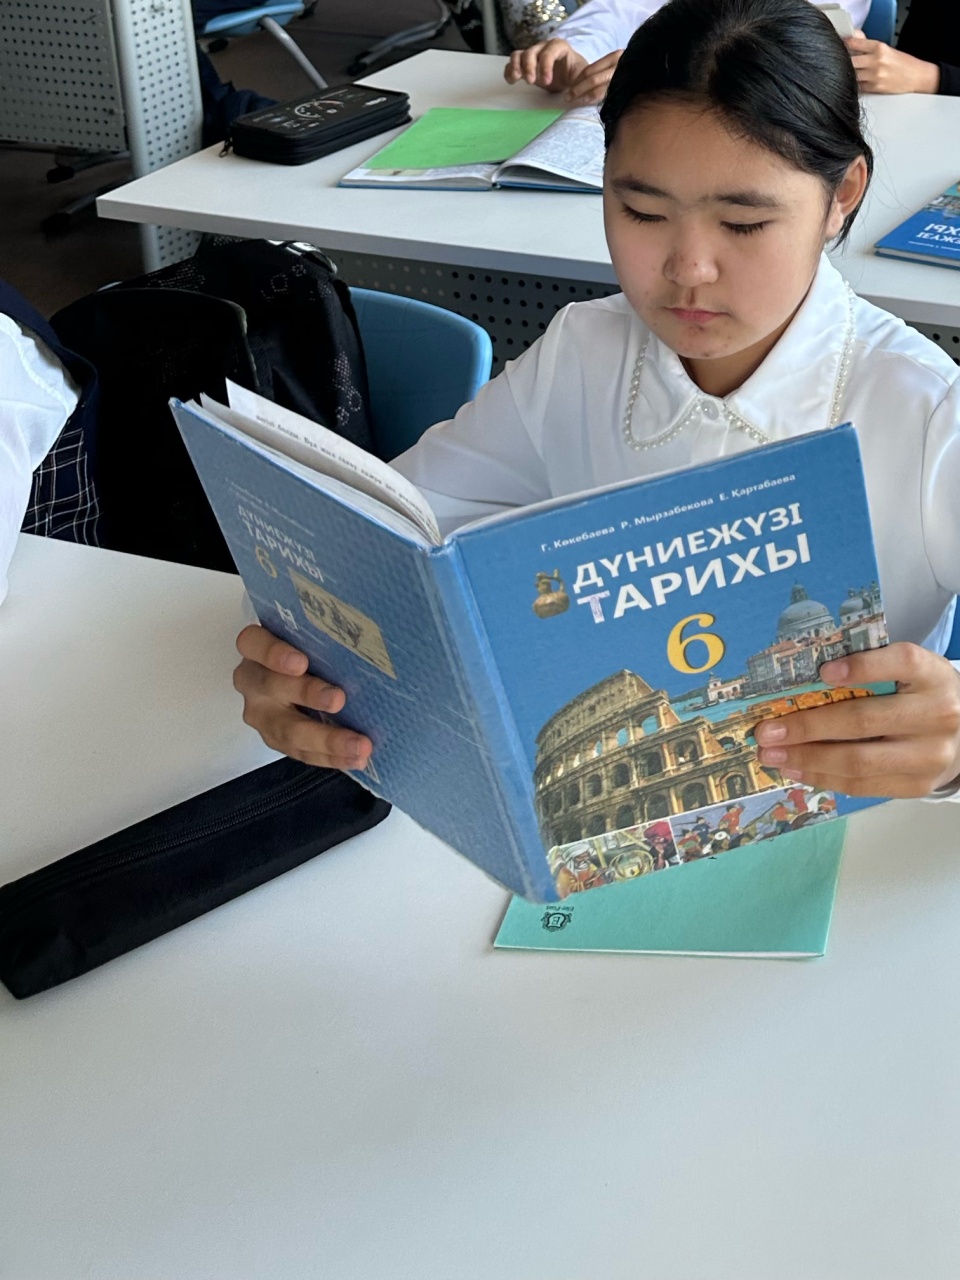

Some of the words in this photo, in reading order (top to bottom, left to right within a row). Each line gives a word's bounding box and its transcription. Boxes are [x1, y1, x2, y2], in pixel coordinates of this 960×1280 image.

[243, 518, 324, 583] ТАРИХЫ
[541, 542, 551, 552] Г.
[554, 526, 615, 548] Көкебаева
[620, 519, 632, 530] Р.
[634, 498, 714, 526] Мырзабекова
[719, 492, 729, 502] Е.
[572, 502, 803, 594] ДҮНИЕЖҮЗІ
[255, 545, 278, 579] 6
[576, 532, 812, 624] ТАРИХЫ
[666, 612, 727, 675] 6
